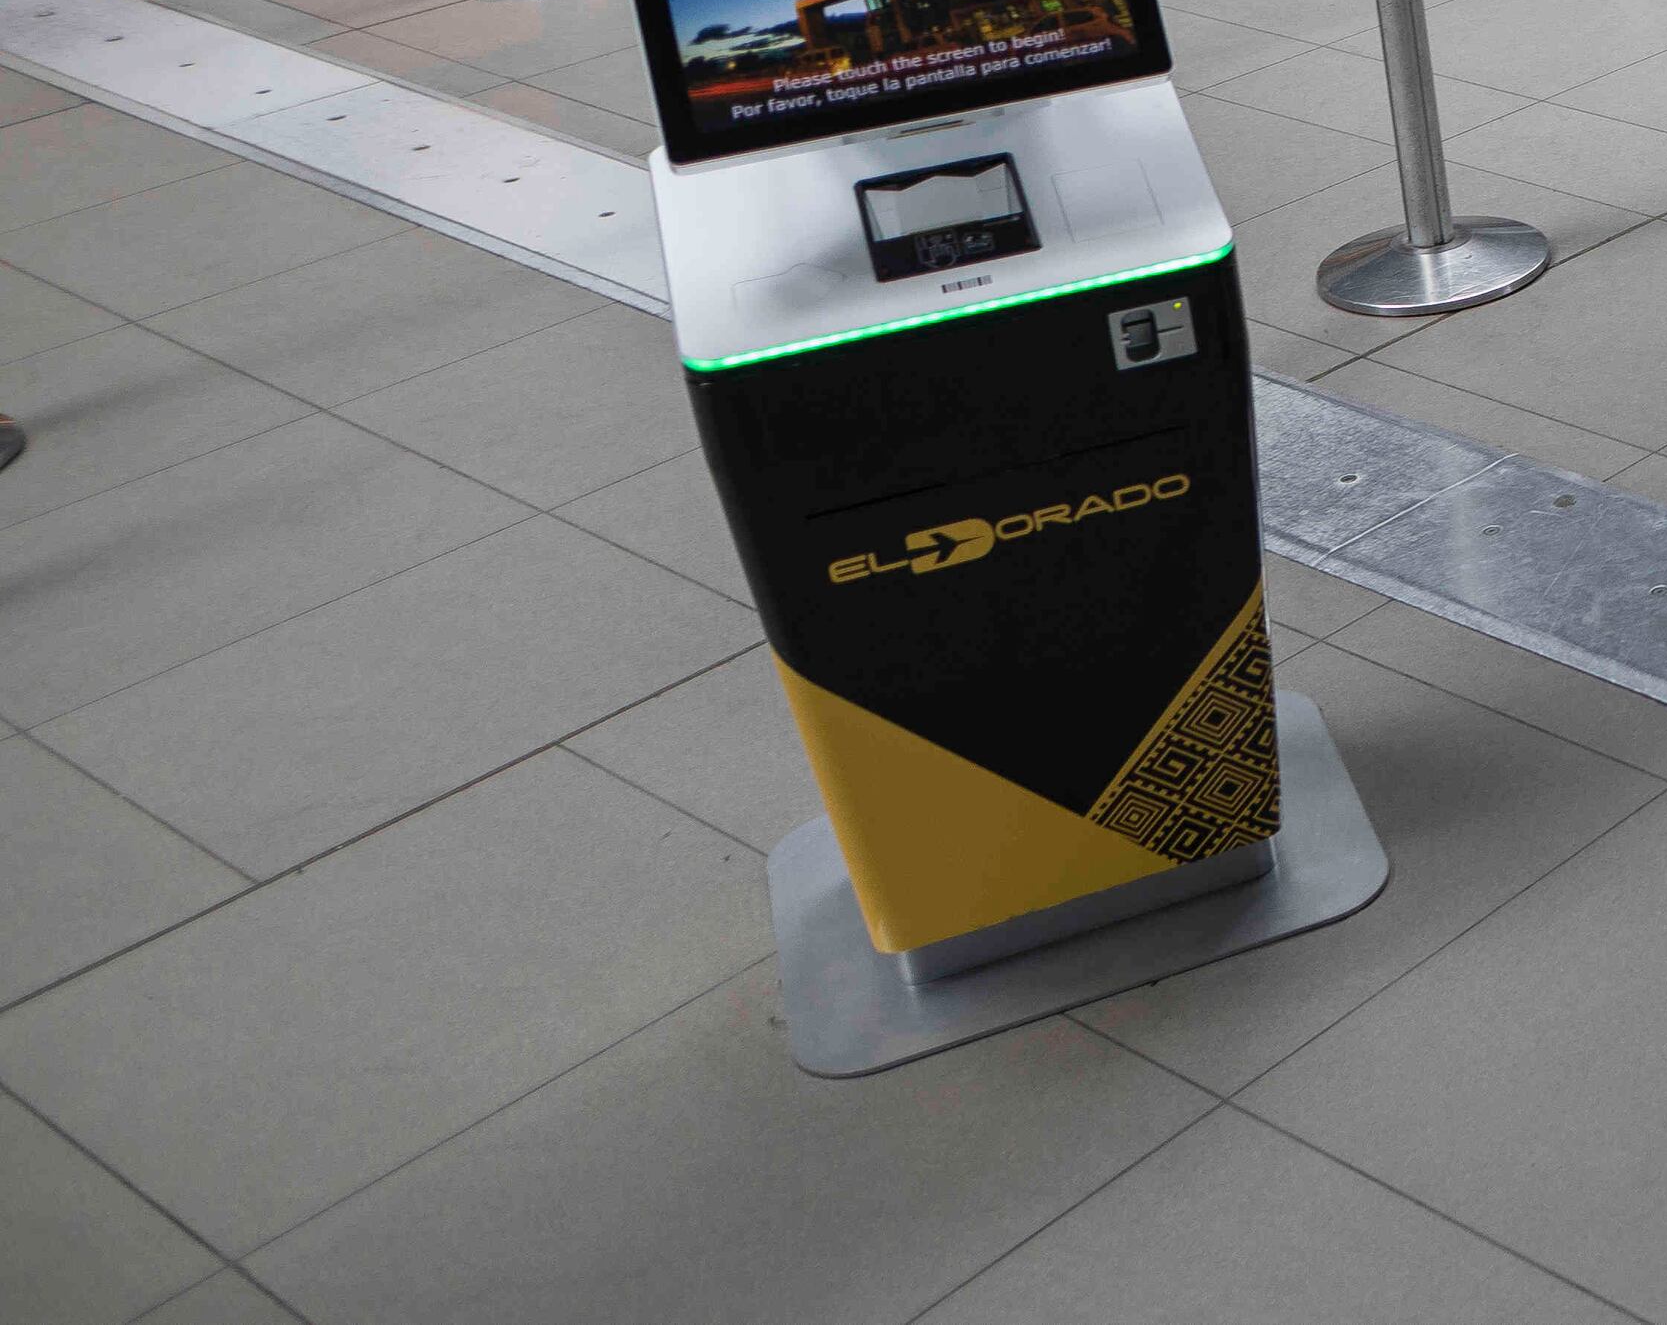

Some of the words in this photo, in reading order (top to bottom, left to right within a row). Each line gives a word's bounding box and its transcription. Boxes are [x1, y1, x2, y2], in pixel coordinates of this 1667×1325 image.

[731, 102, 763, 120] Por
[767, 90, 823, 113] favor,
[826, 81, 880, 104] toque
[882, 77, 902, 92] la
[905, 62, 977, 91] pantalla
[980, 55, 1021, 78] para
[1024, 37, 1113, 66] comenzar!
[773, 72, 832, 94] Please
[837, 60, 889, 82] touch
[892, 53, 924, 71] the
[926, 43, 985, 66] screen
[988, 39, 1008, 54] to
[1011, 26, 1066, 51] begin!
